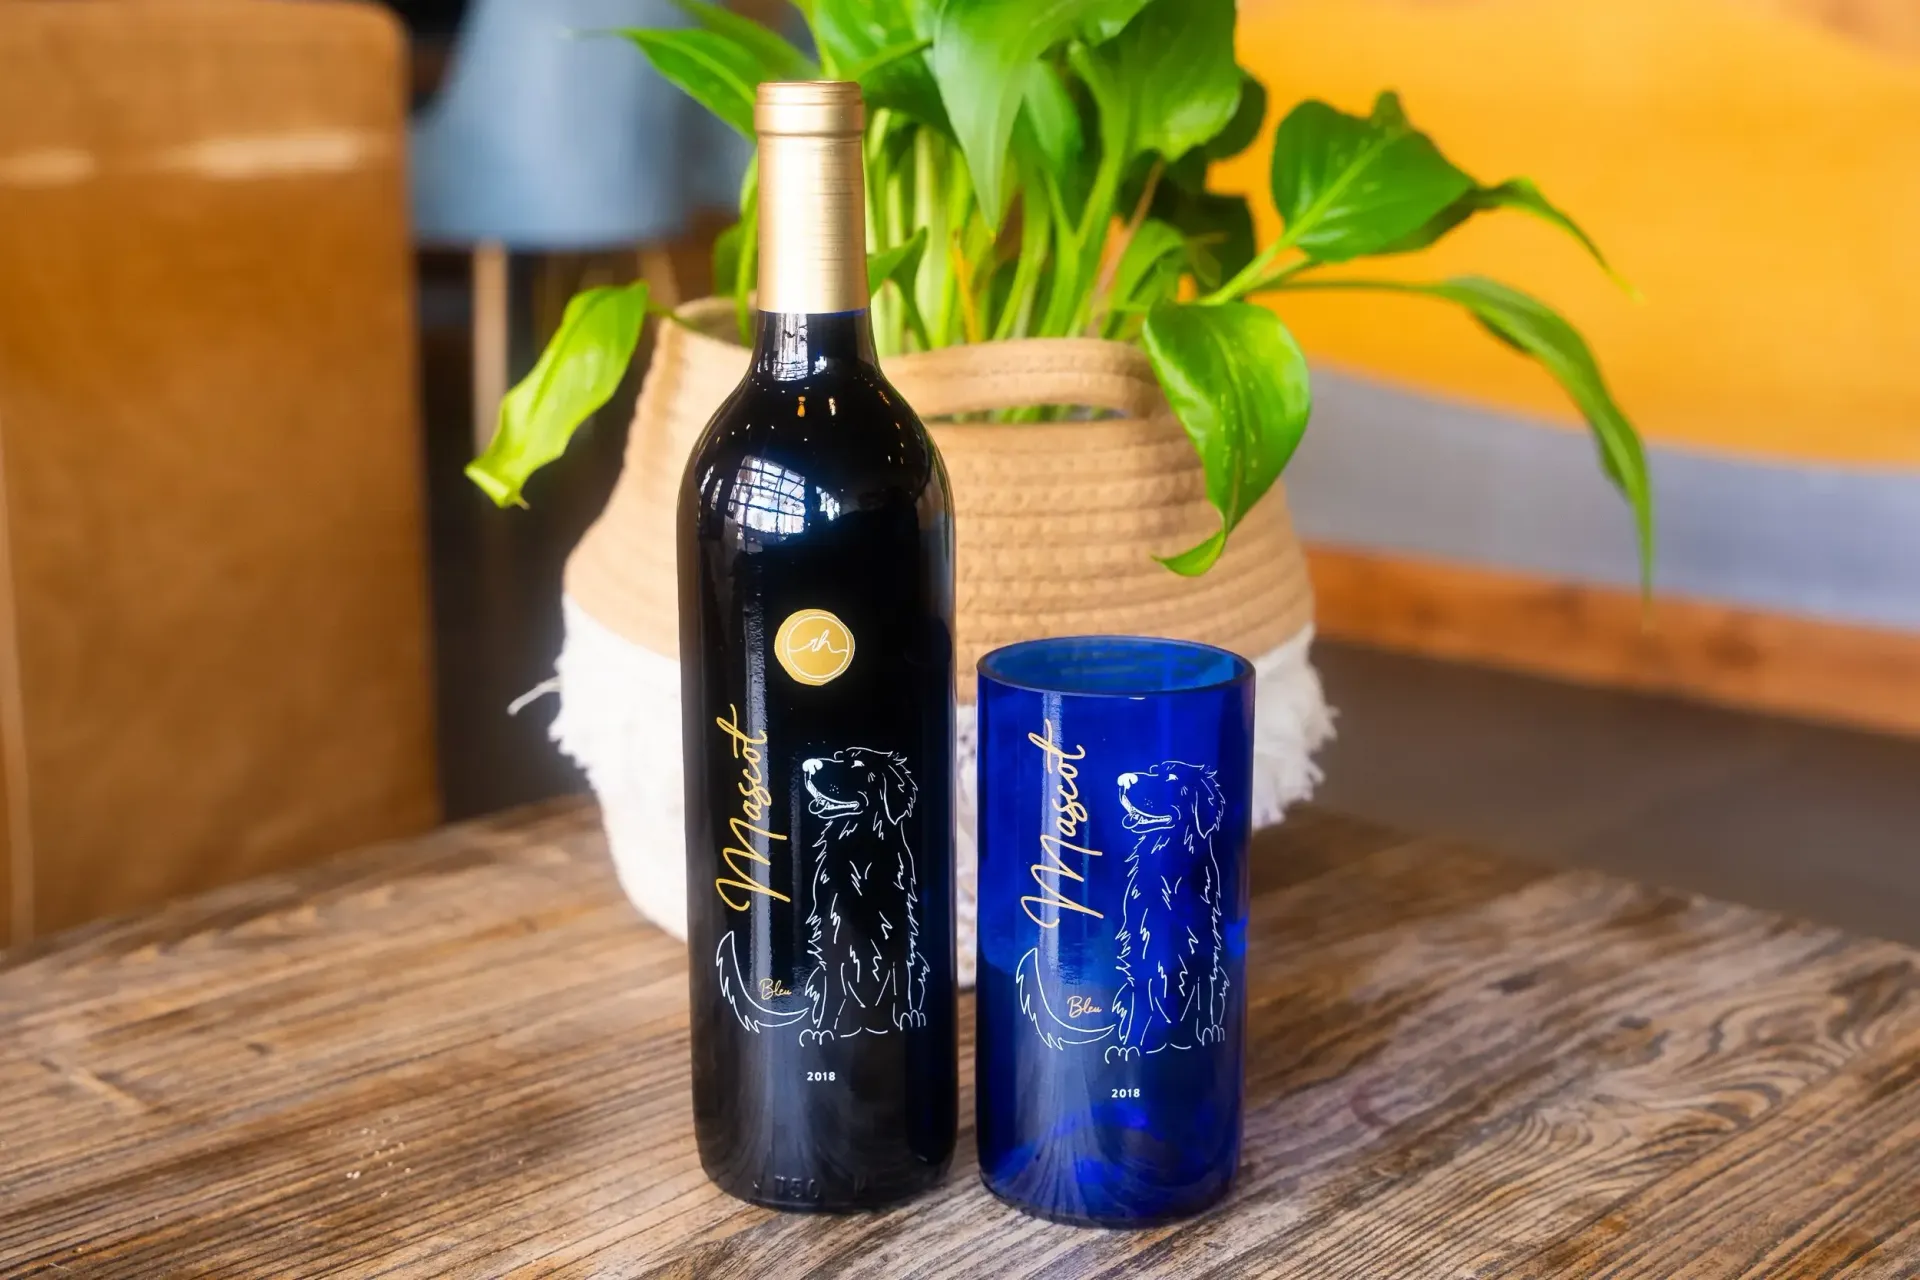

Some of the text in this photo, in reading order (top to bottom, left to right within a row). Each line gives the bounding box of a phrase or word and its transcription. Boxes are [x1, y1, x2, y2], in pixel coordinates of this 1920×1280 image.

[716, 703, 791, 911] Mascot
[1020, 718, 1104, 928] Mascot
[760, 978, 792, 1000] Bleu
[1066, 995, 1102, 1018] Bleu
[806, 1071, 836, 1082] 2018
[1111, 1088, 1141, 1099] 2018
